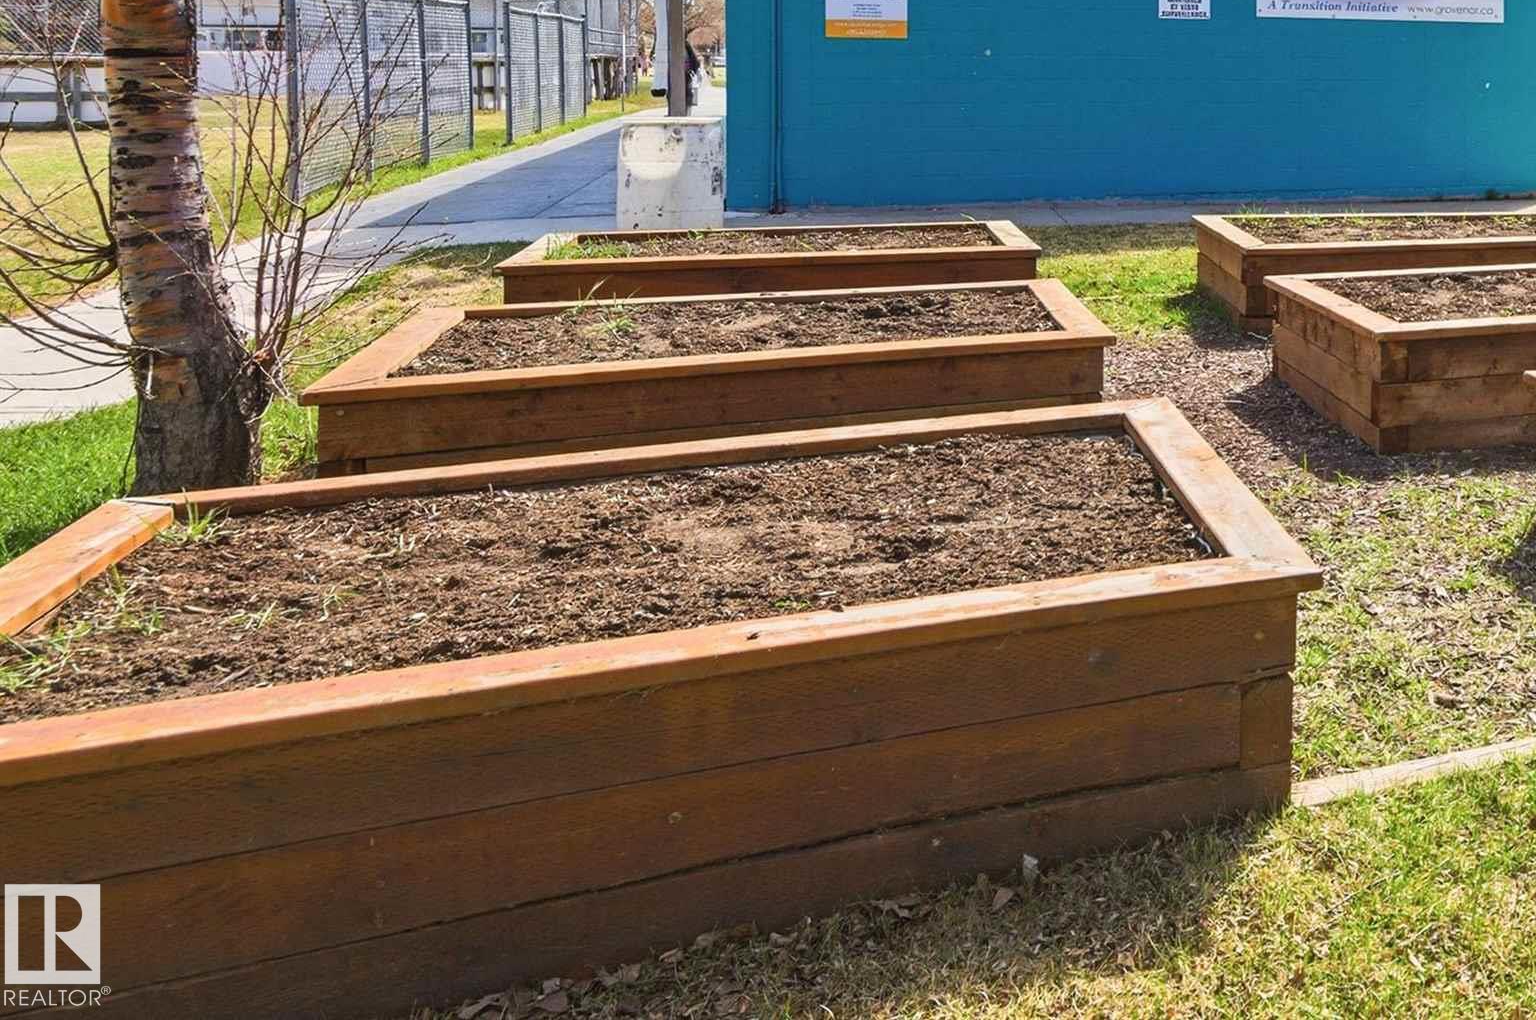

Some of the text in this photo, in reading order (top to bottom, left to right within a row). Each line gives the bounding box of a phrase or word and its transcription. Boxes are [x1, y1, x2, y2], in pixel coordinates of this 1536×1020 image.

[1267, 0, 1399, 13] A Transition Initiative
